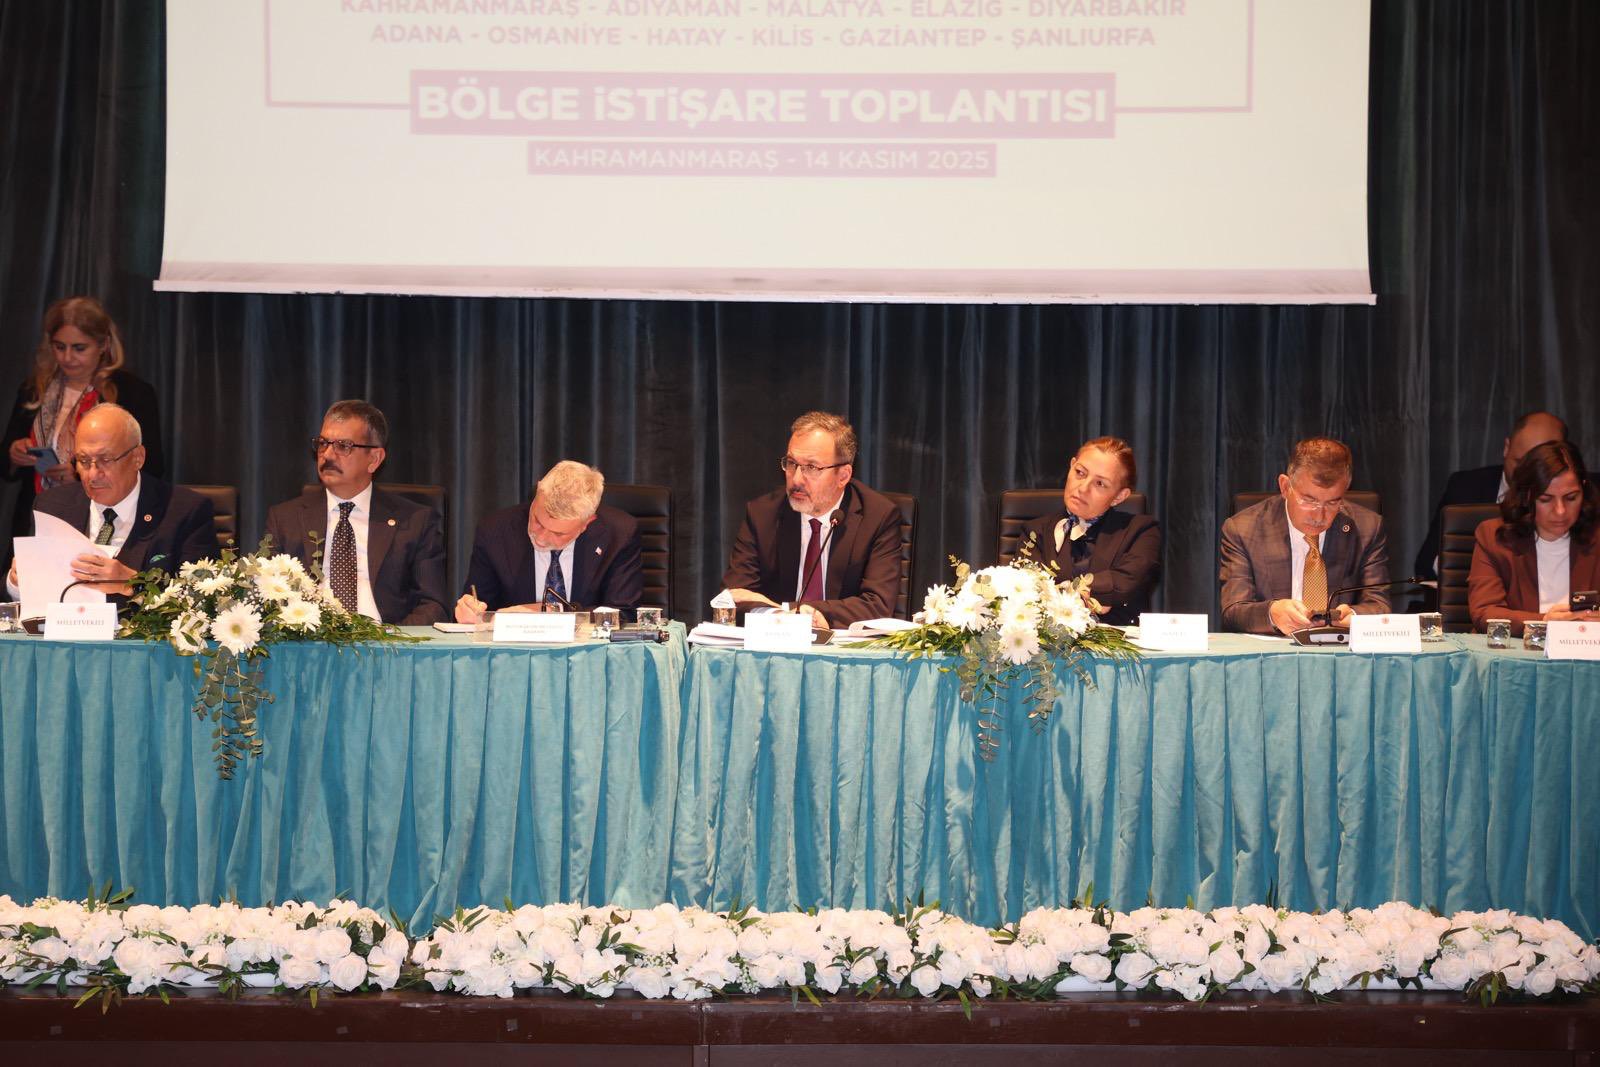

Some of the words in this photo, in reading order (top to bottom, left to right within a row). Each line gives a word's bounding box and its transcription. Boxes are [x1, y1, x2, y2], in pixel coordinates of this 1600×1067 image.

[341, 0, 579, 19] KAHRAMANMARAŞ
[606, 0, 740, 16] ADIYAMAN
[768, 0, 885, 17] MALATYA
[371, 24, 462, 43] ADANA
[488, 22, 622, 45] OSMANİYE
[647, 26, 726, 46] HATAY
[753, 24, 814, 47] KİLİS
[840, 23, 987, 47] GAZİANTEP
[1011, 28, 1156, 49] ŞANLIURFA
[418, 77, 580, 121] BÖLGE
[821, 88, 1107, 123] TOPLANTISI
[535, 149, 779, 172] KAHRAMANMARAŞ
[805, 150, 830, 168] 14
[839, 150, 918, 169] KASIM
[928, 150, 988, 169] 2025
